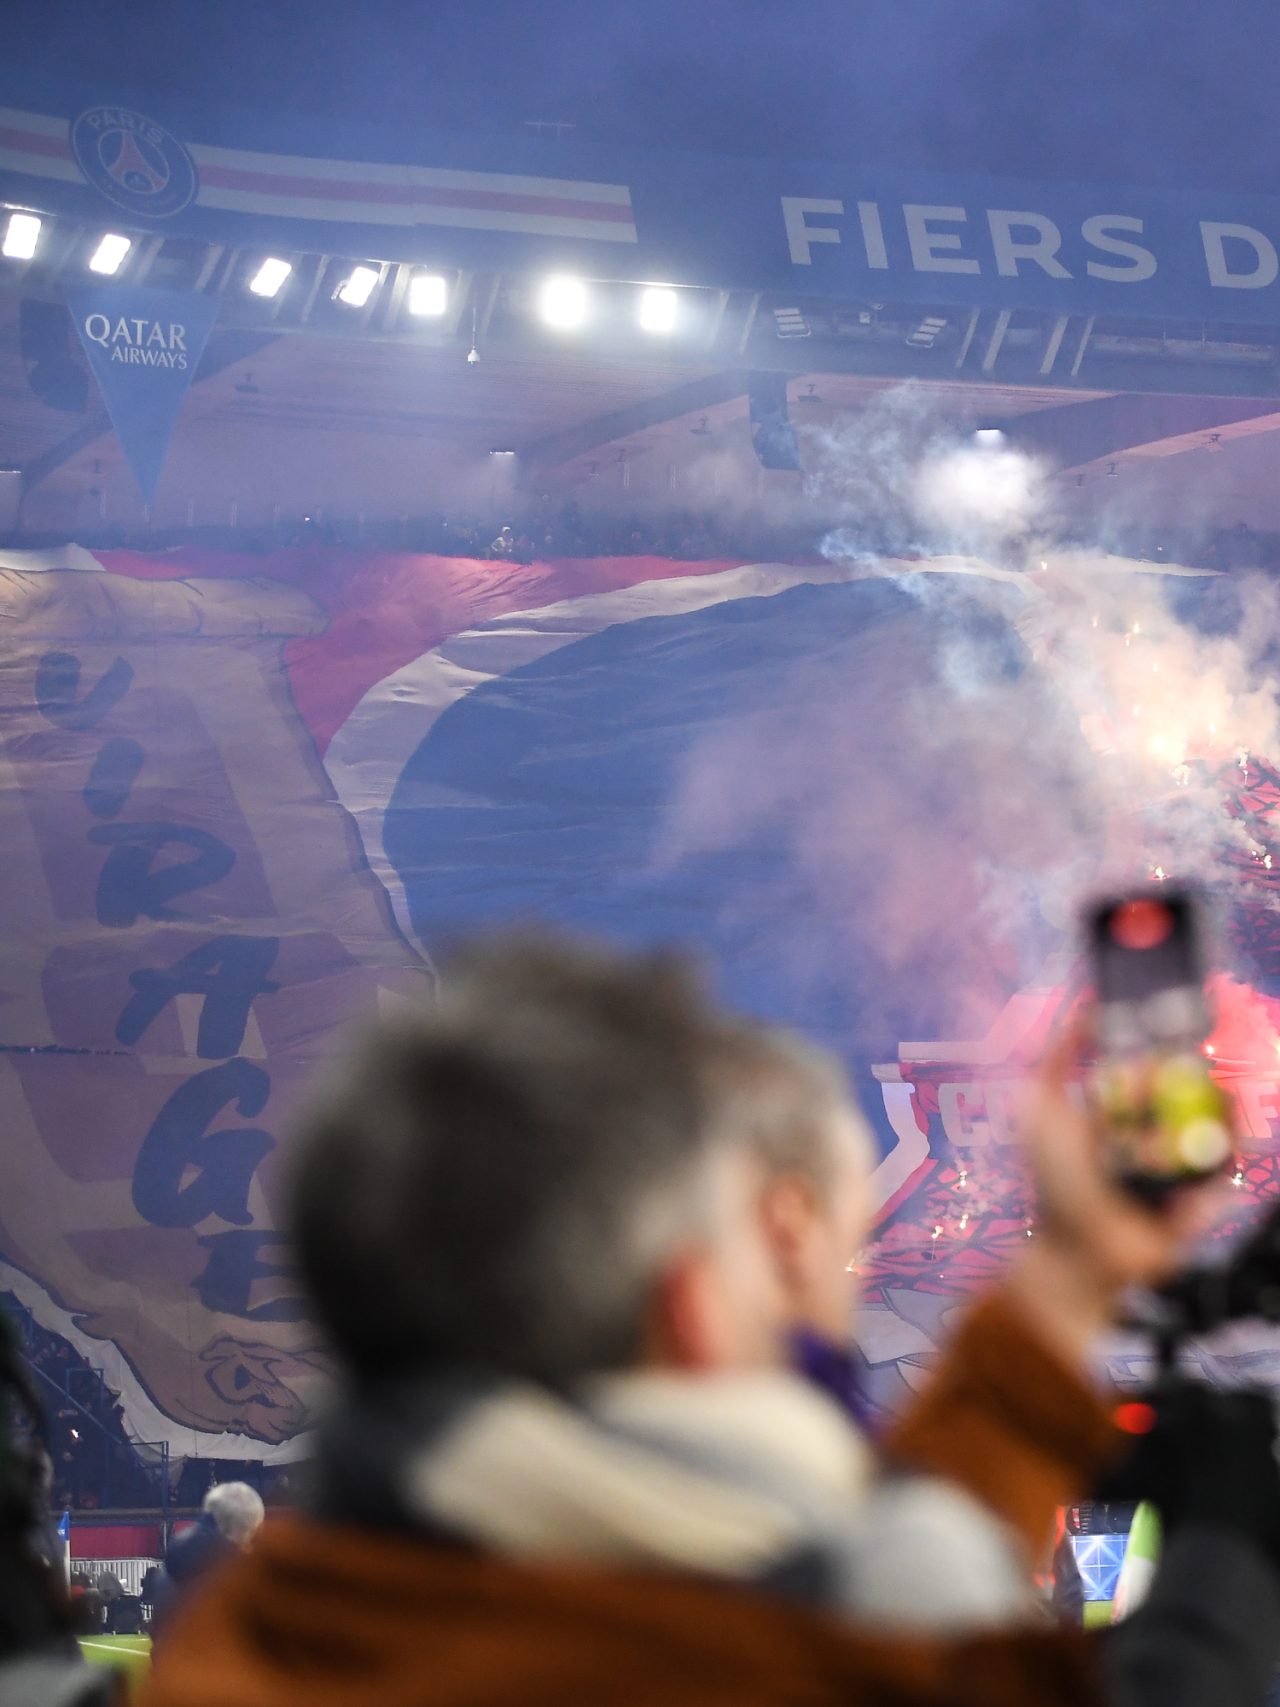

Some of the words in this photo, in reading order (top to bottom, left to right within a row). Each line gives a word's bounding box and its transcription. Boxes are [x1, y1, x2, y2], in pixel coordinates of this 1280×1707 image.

[86, 111, 164, 144] PARIS
[781, 197, 1158, 282] FIERS
[85, 313, 187, 350] QATAR
[111, 345, 188, 370] AIRWAYS
